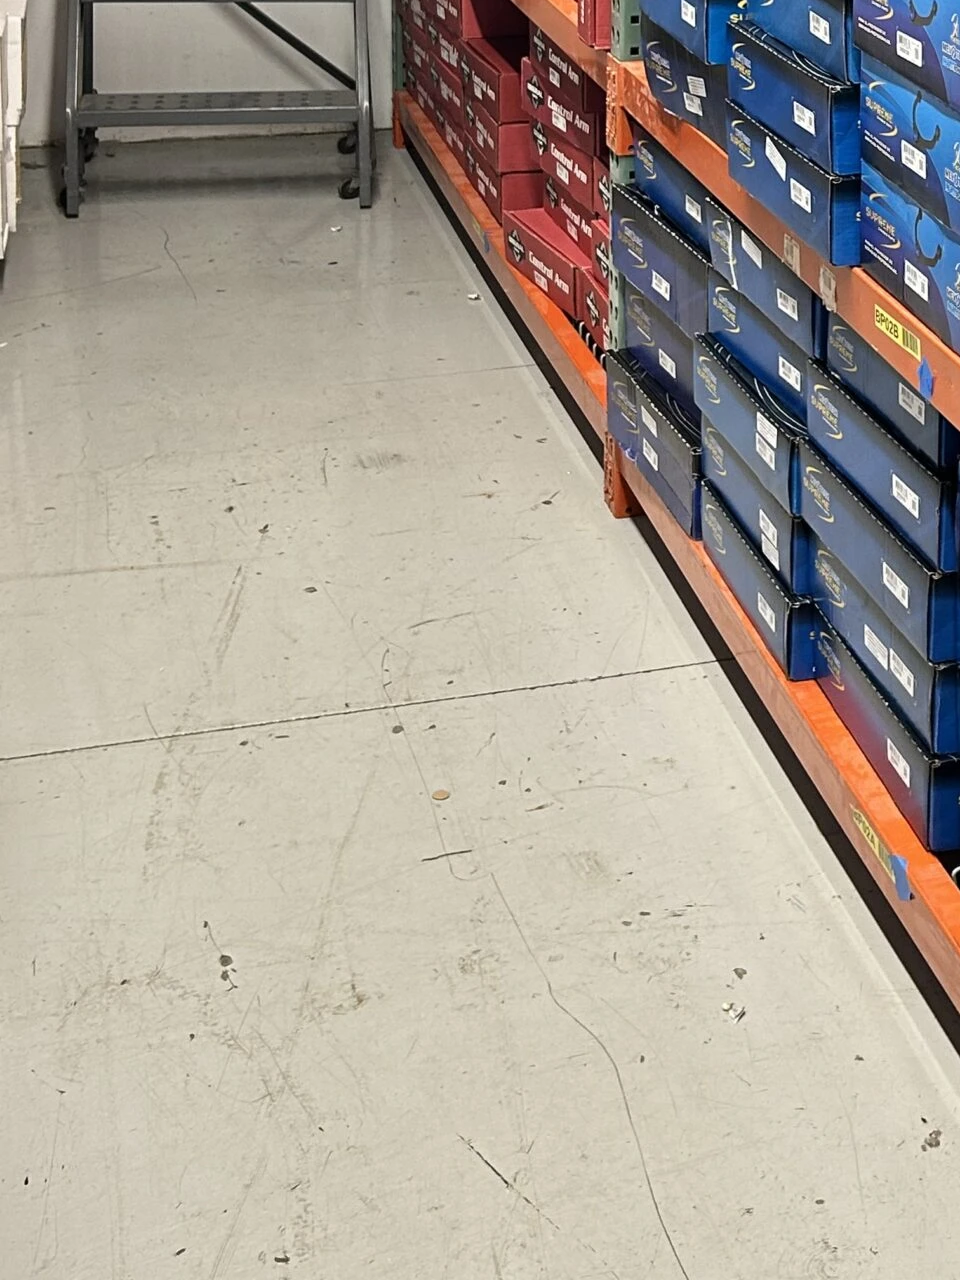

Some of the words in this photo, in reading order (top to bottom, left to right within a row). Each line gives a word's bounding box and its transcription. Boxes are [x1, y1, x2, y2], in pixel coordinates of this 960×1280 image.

[549, 48, 568, 76] Control
[568, 65, 580, 86] Arm
[547, 96, 574, 124] Control
[575, 114, 590, 136] Arm
[865, 96, 893, 122] SUPREME
[551, 143, 575, 173] Control
[575, 163, 588, 185] Arm
[865, 206, 896, 235] SUPREME
[528, 251, 553, 280] Control
[554, 272, 569, 295] Arm
[875, 308, 899, 339] BP02B
